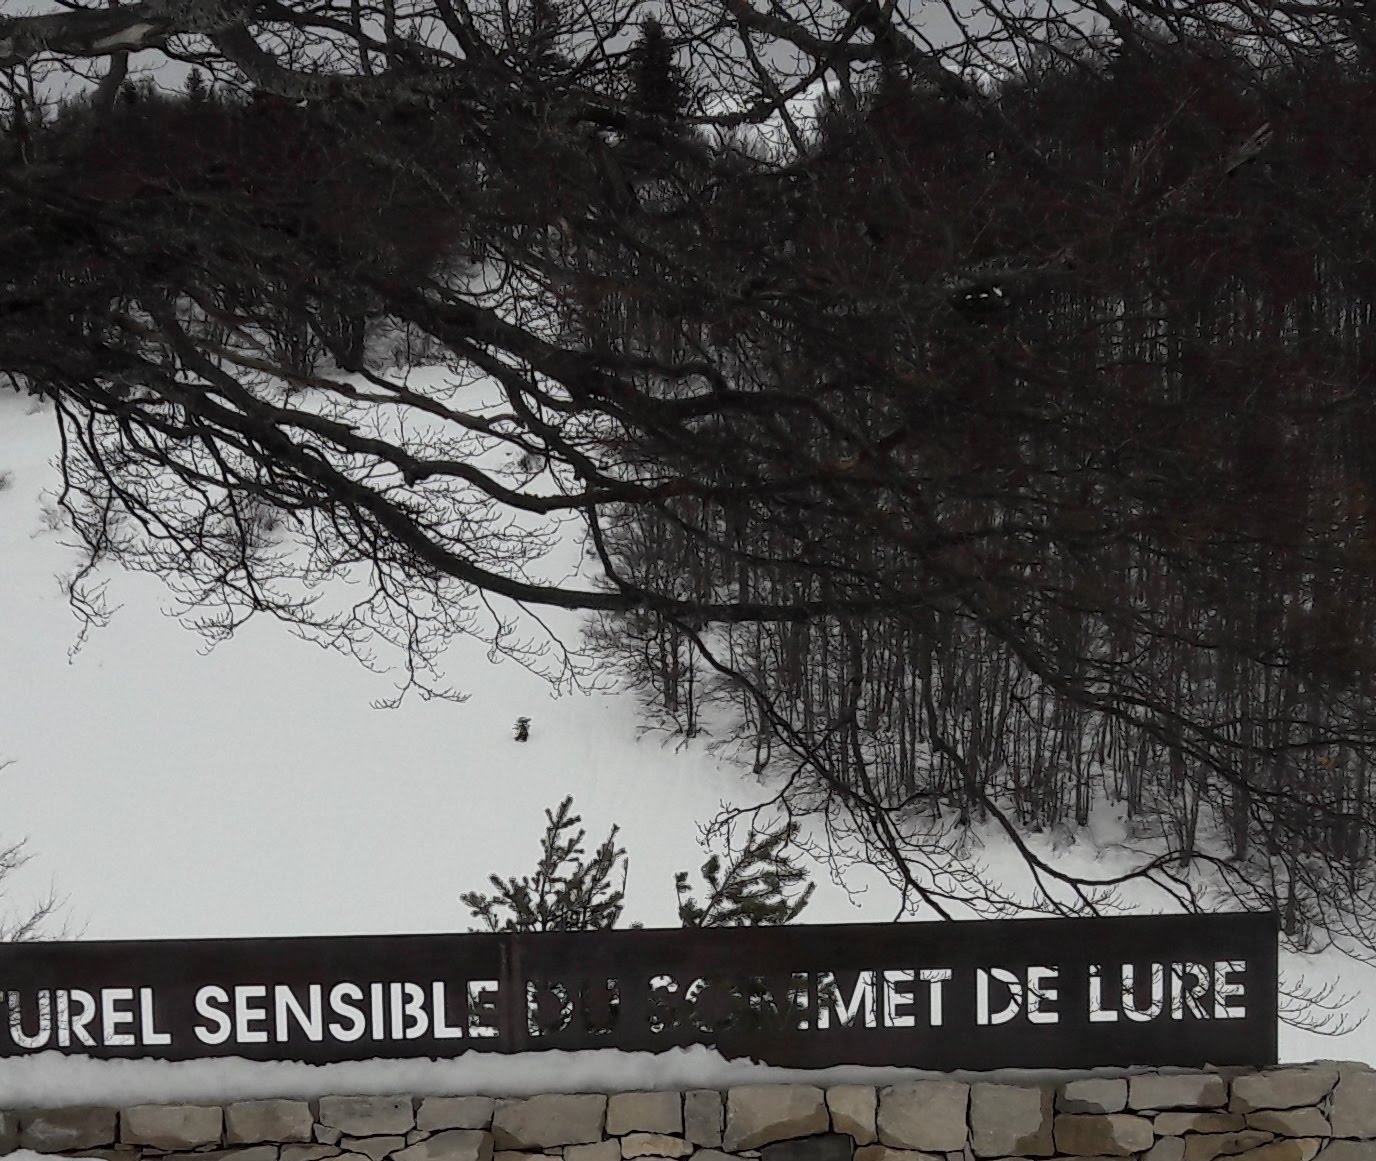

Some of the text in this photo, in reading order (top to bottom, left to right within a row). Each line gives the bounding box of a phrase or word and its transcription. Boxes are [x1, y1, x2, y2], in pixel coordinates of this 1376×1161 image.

[193, 979, 499, 1045] SENSIBLE
[976, 966, 1059, 1026] DE
[1088, 960, 1247, 1023] LURE
